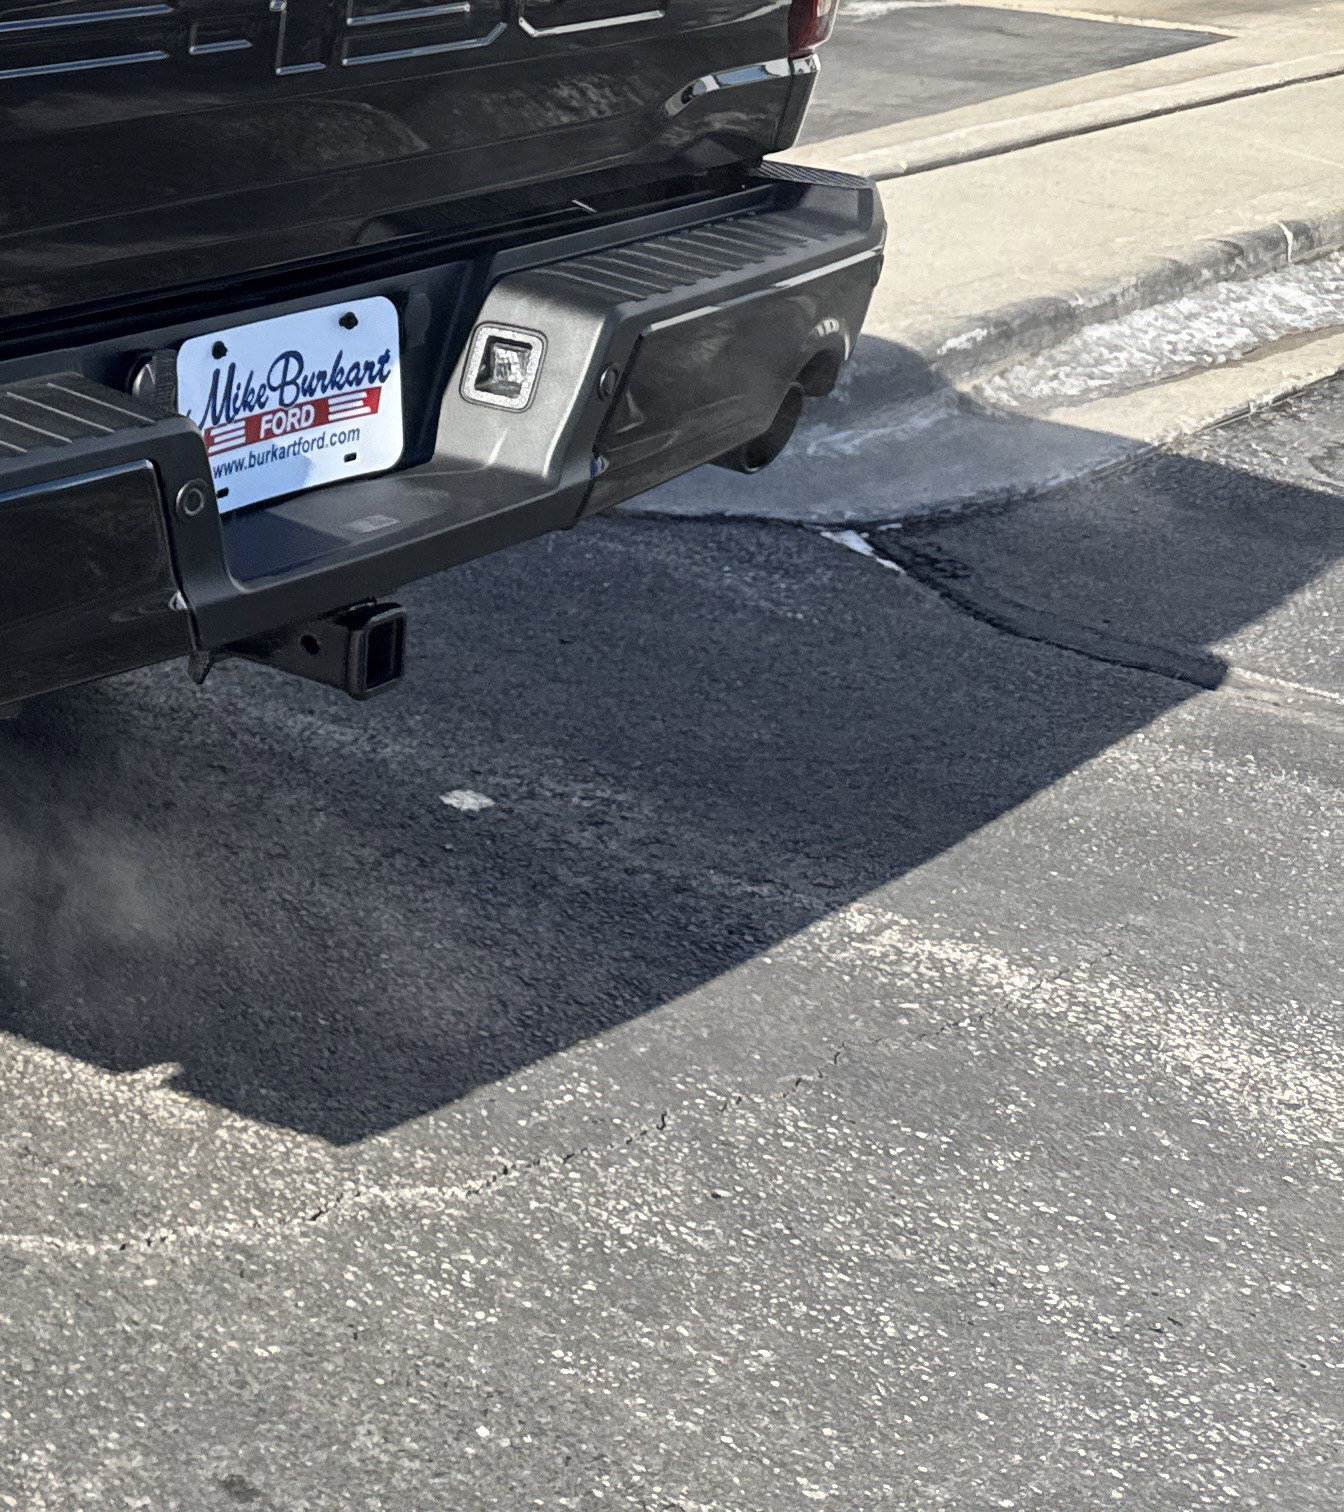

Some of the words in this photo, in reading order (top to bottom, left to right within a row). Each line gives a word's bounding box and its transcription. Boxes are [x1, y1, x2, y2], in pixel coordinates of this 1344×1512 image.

[186, 362, 269, 430] Mike
[267, 349, 392, 407] Burkart
[259, 406, 315, 439] FORD
[213, 427, 360, 479] www.burkartford.com
